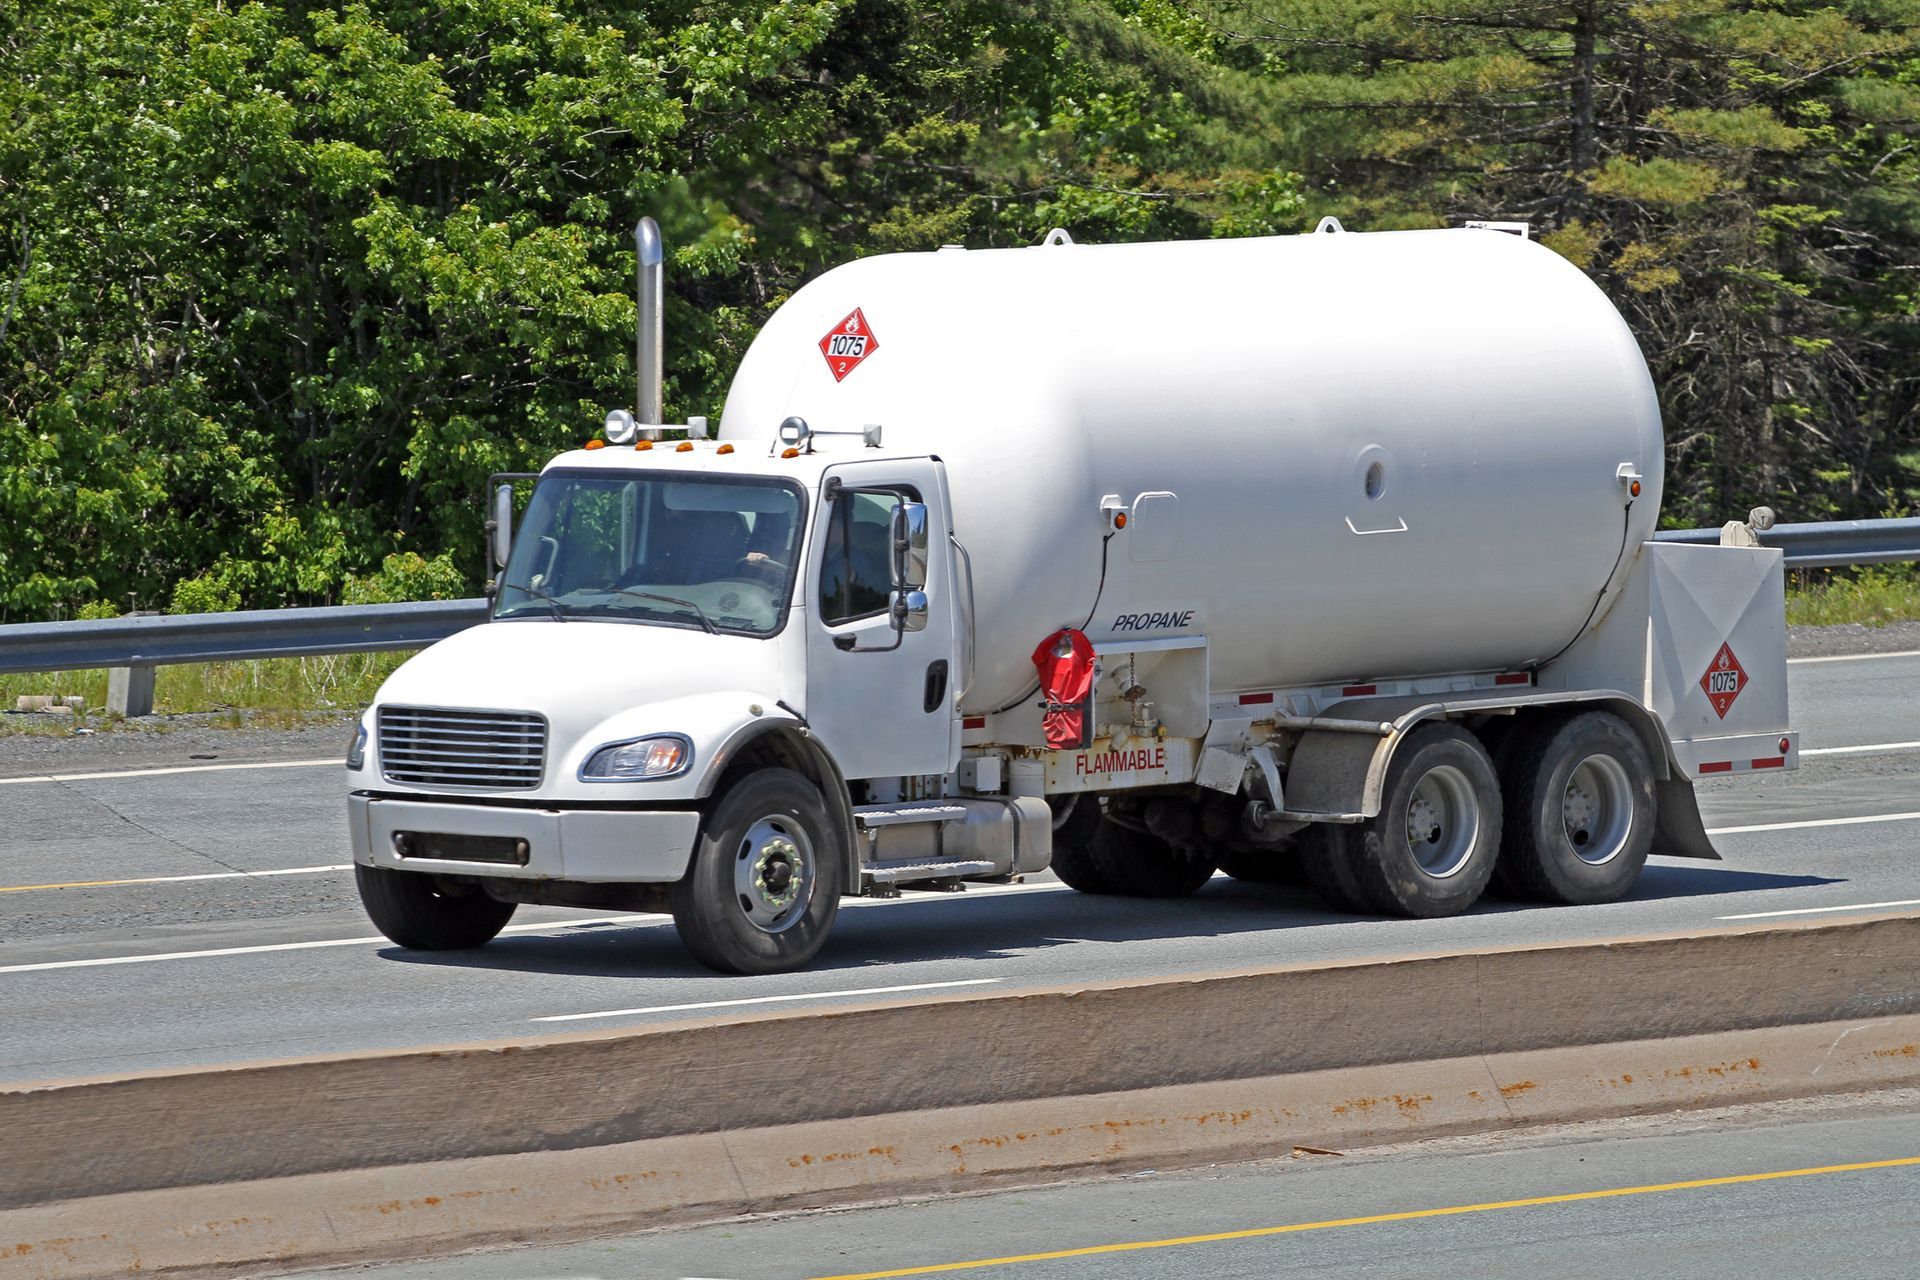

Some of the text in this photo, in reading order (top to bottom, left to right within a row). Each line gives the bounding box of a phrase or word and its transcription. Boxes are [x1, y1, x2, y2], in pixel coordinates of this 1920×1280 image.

[831, 336, 864, 356] 1075
[838, 362, 847, 373] 2
[1111, 610, 1195, 632] PROPANE
[1711, 671, 1737, 692] 1075
[1719, 698, 1726, 709] 2
[1076, 748, 1165, 776] FLAMMABLE
